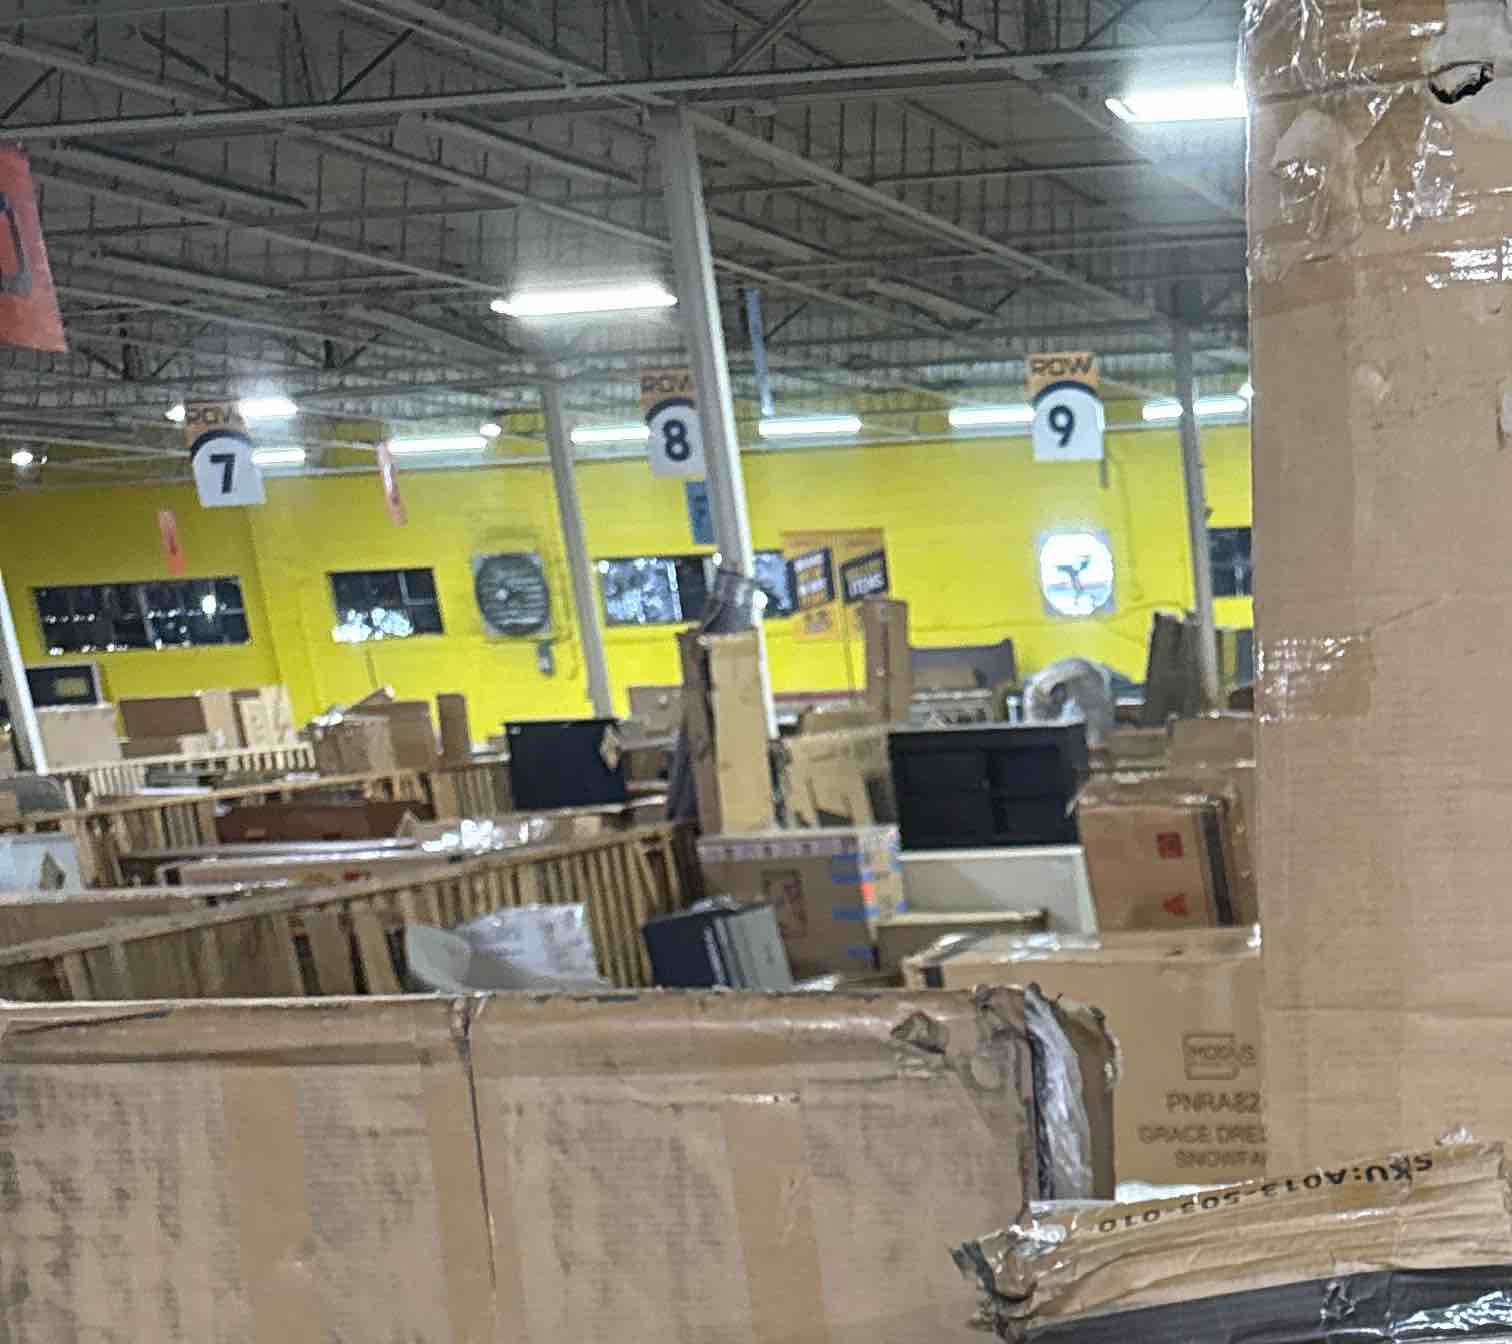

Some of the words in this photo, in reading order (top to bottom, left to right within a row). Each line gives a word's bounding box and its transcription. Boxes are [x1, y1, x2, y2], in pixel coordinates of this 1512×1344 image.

[1031, 356, 1094, 377] ROW
[662, 418, 691, 463] 8
[1049, 404, 1075, 448] 9
[209, 452, 236, 495] 7
